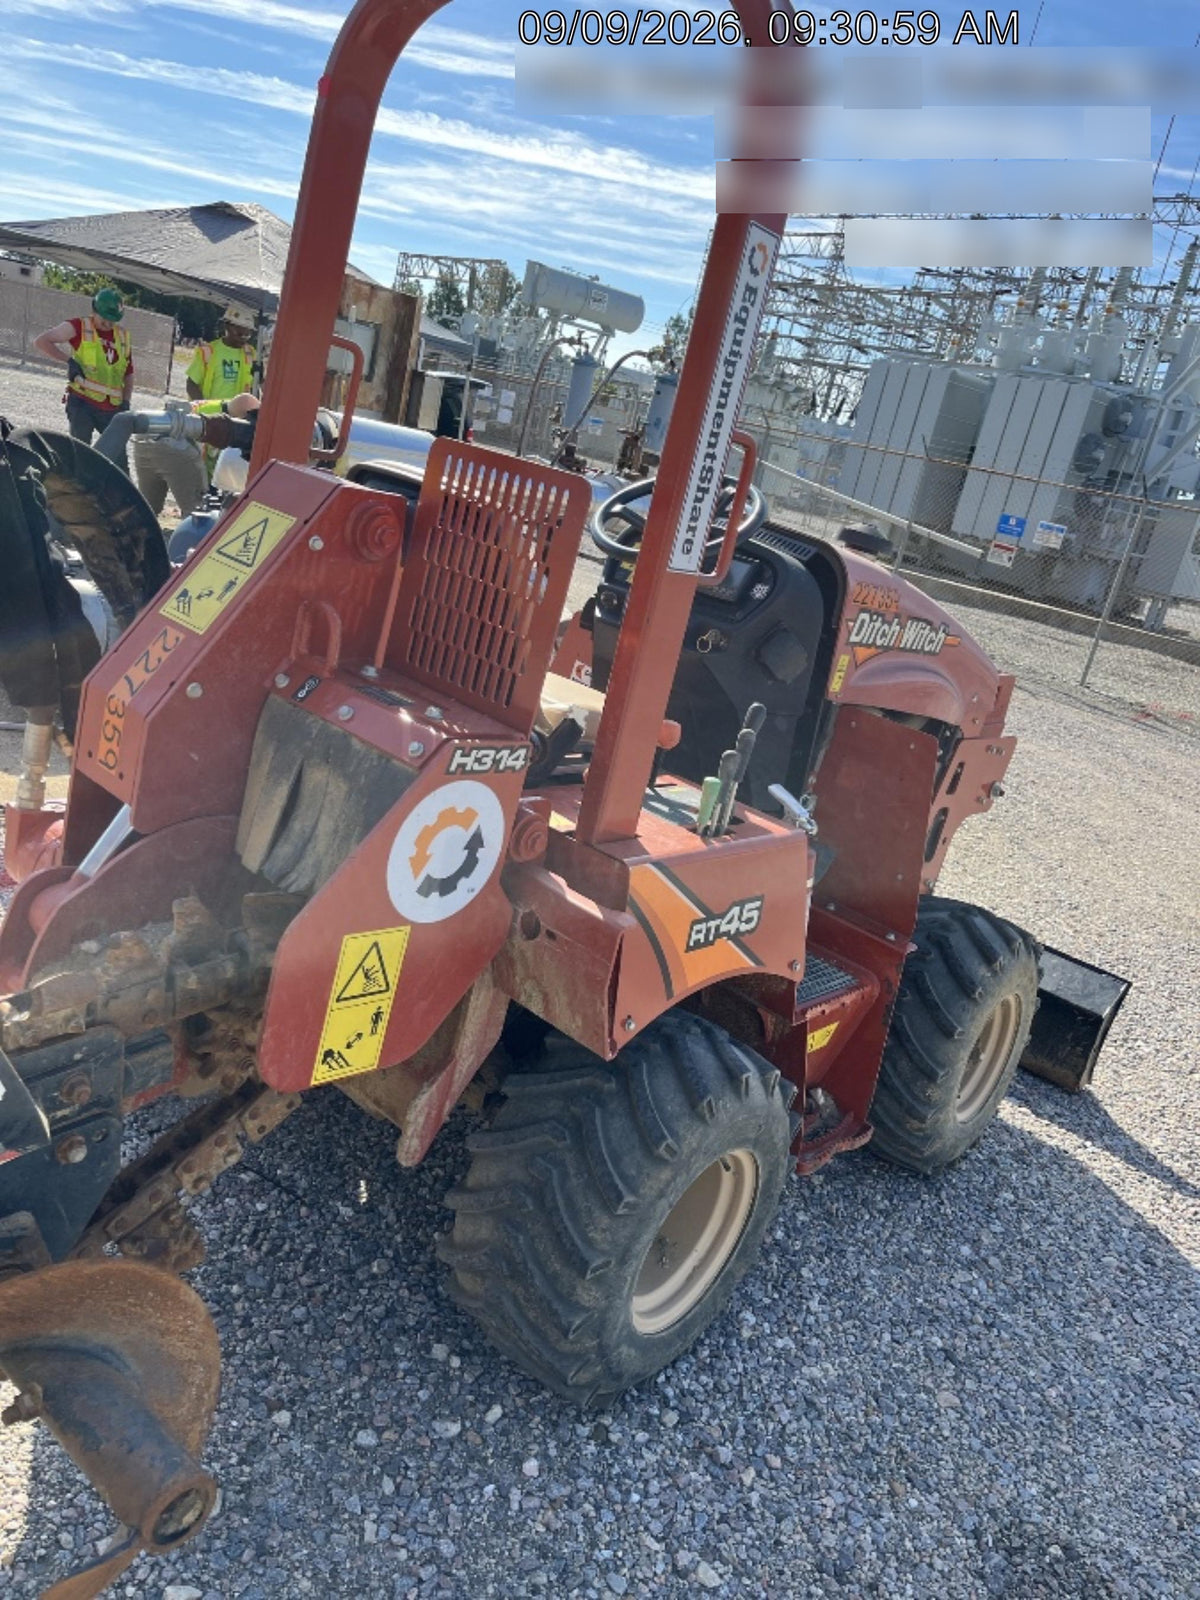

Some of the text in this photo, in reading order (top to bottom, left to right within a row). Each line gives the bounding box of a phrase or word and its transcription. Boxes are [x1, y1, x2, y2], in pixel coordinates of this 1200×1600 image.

[682, 282, 758, 556] EquipmentShare
[847, 611, 948, 654] Ditch Witch
[99, 628, 180, 770] 227359
[447, 747, 528, 773] H314
[688, 899, 763, 949] RT45
